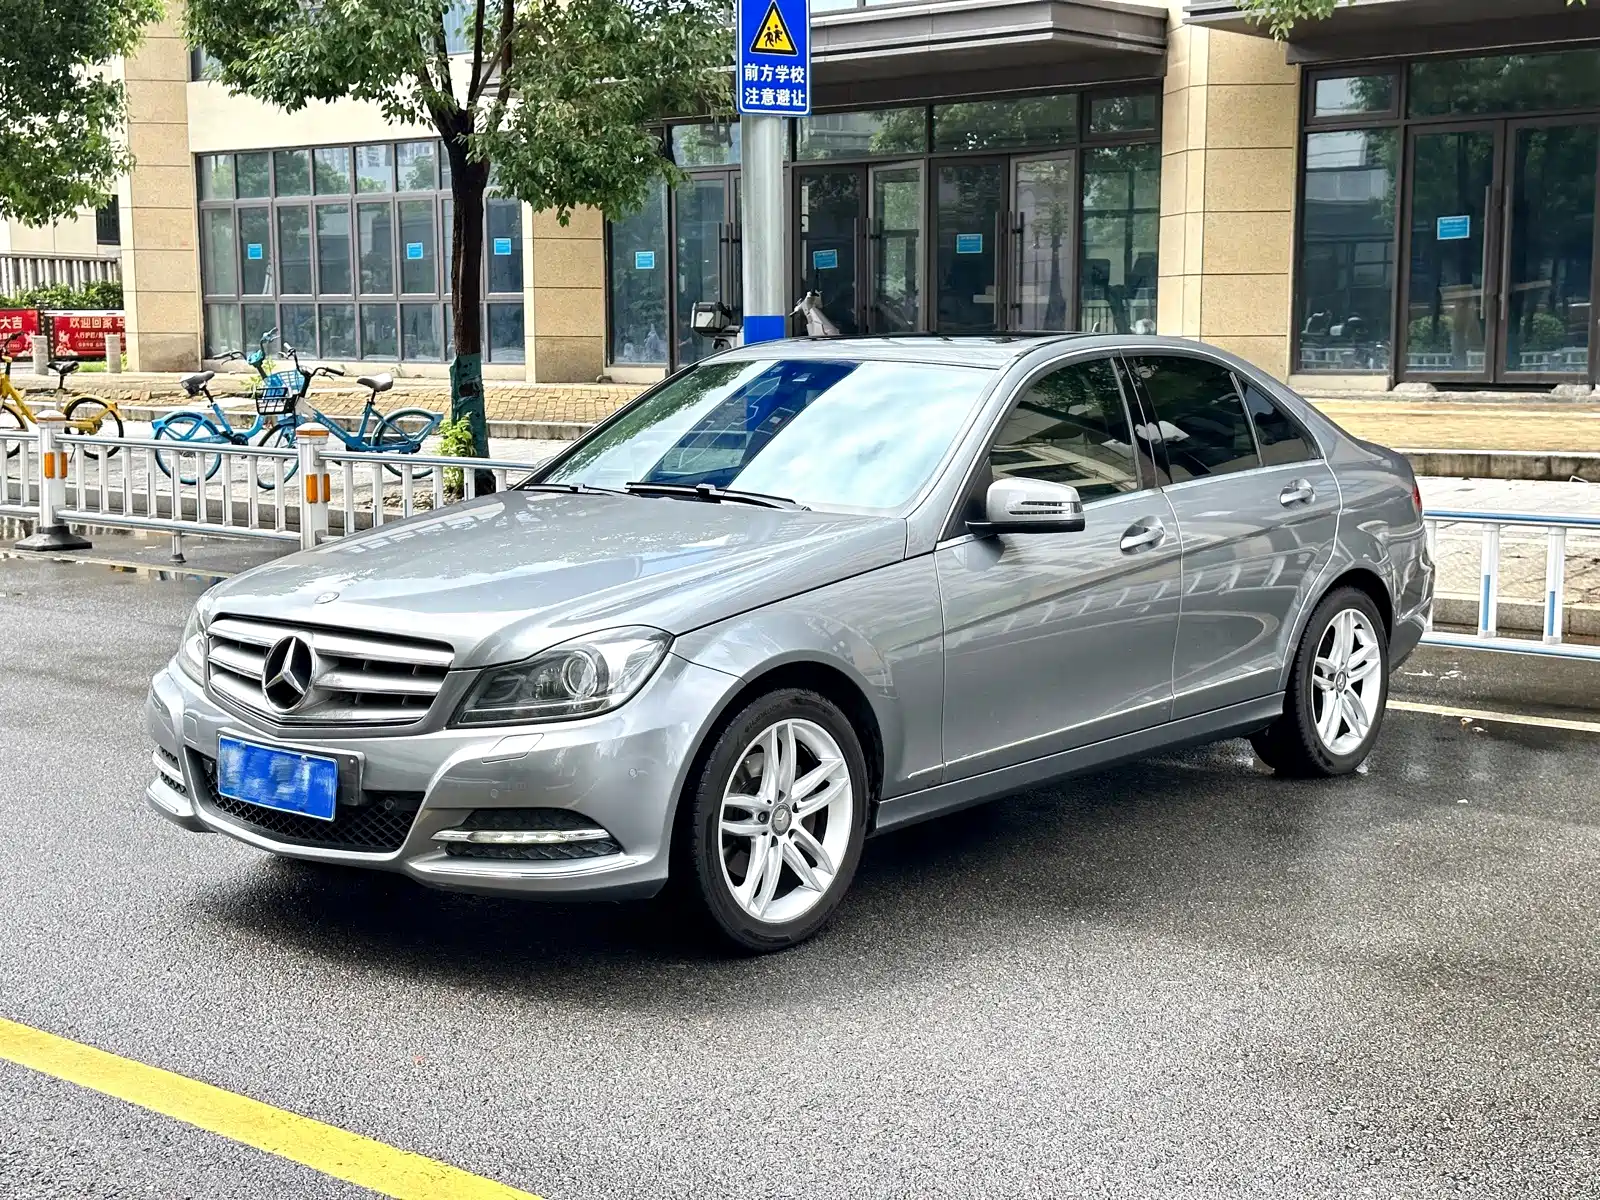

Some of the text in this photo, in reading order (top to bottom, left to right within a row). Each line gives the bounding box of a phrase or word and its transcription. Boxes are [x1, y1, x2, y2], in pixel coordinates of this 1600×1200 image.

[744, 63, 805, 83] 前方学校
[745, 87, 806, 106] 注意避让
[0, 316, 23, 329] 大吉
[69, 317, 113, 329] 欢迎回家
